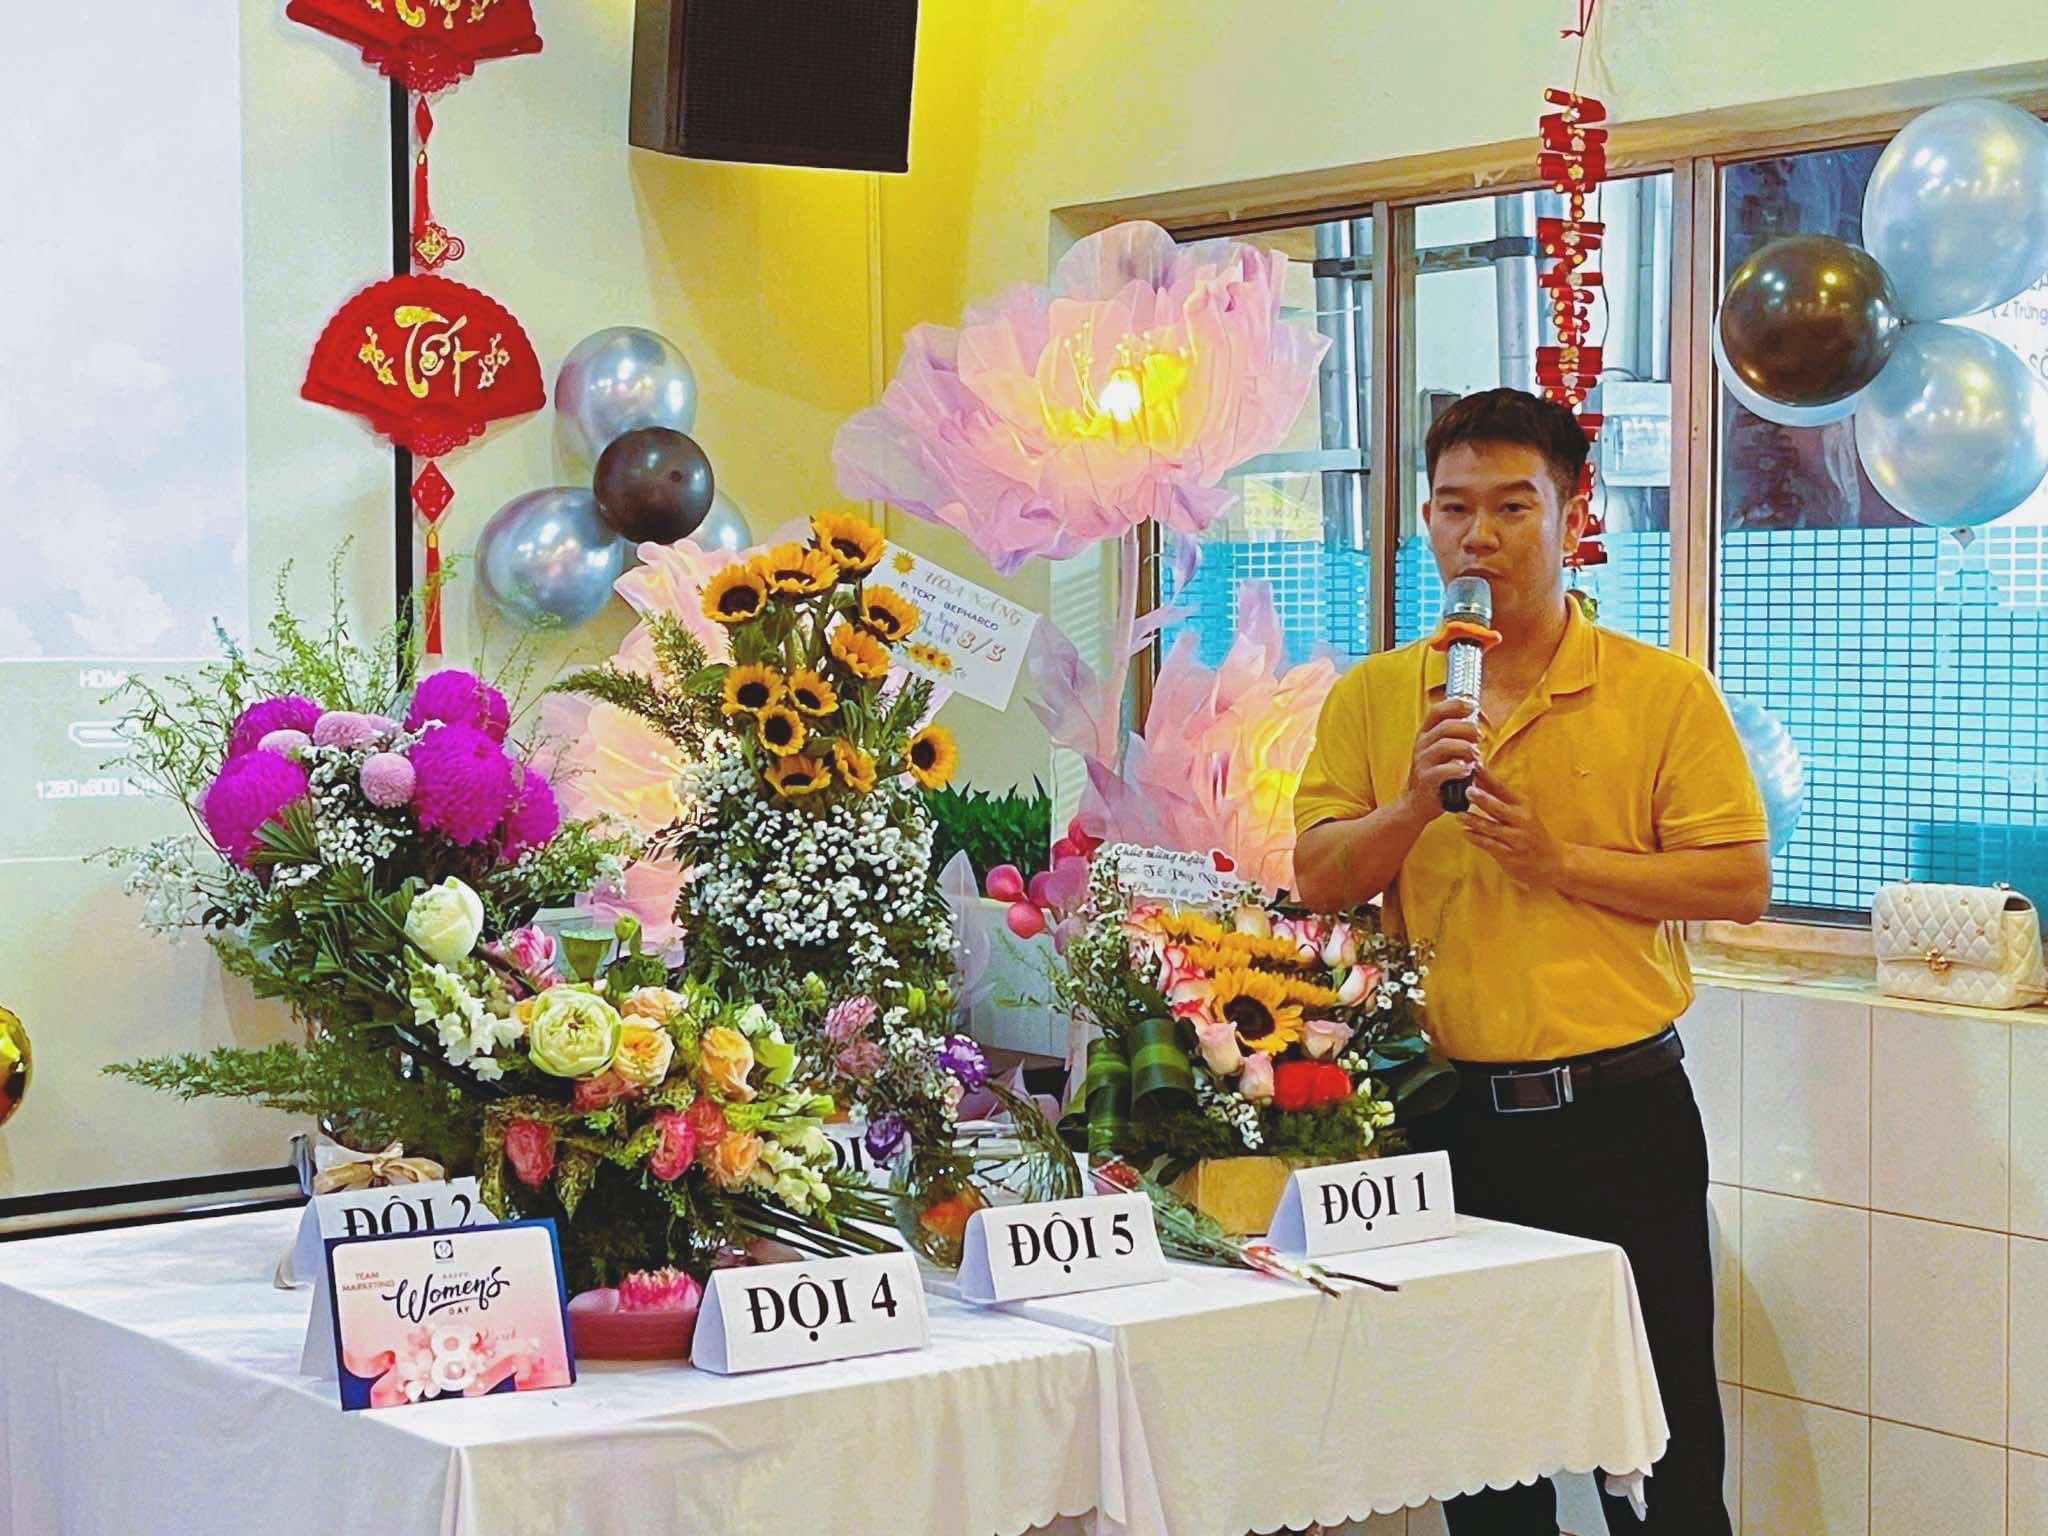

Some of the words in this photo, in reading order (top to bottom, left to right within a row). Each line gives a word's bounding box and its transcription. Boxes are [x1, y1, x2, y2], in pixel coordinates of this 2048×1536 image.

[394, 305, 480, 398] Tết
[79, 670, 130, 688] HDM
[450, 1193, 477, 1229] 2
[1318, 1170, 1400, 1232] ĐỘI
[1411, 1170, 1431, 1213] 1
[1006, 1212, 1100, 1274] ĐỘI
[1110, 1212, 1135, 1256] 5
[381, 1265, 511, 1324] Women's
[743, 1272, 855, 1342] ĐỘI
[870, 1271, 898, 1318] 4
